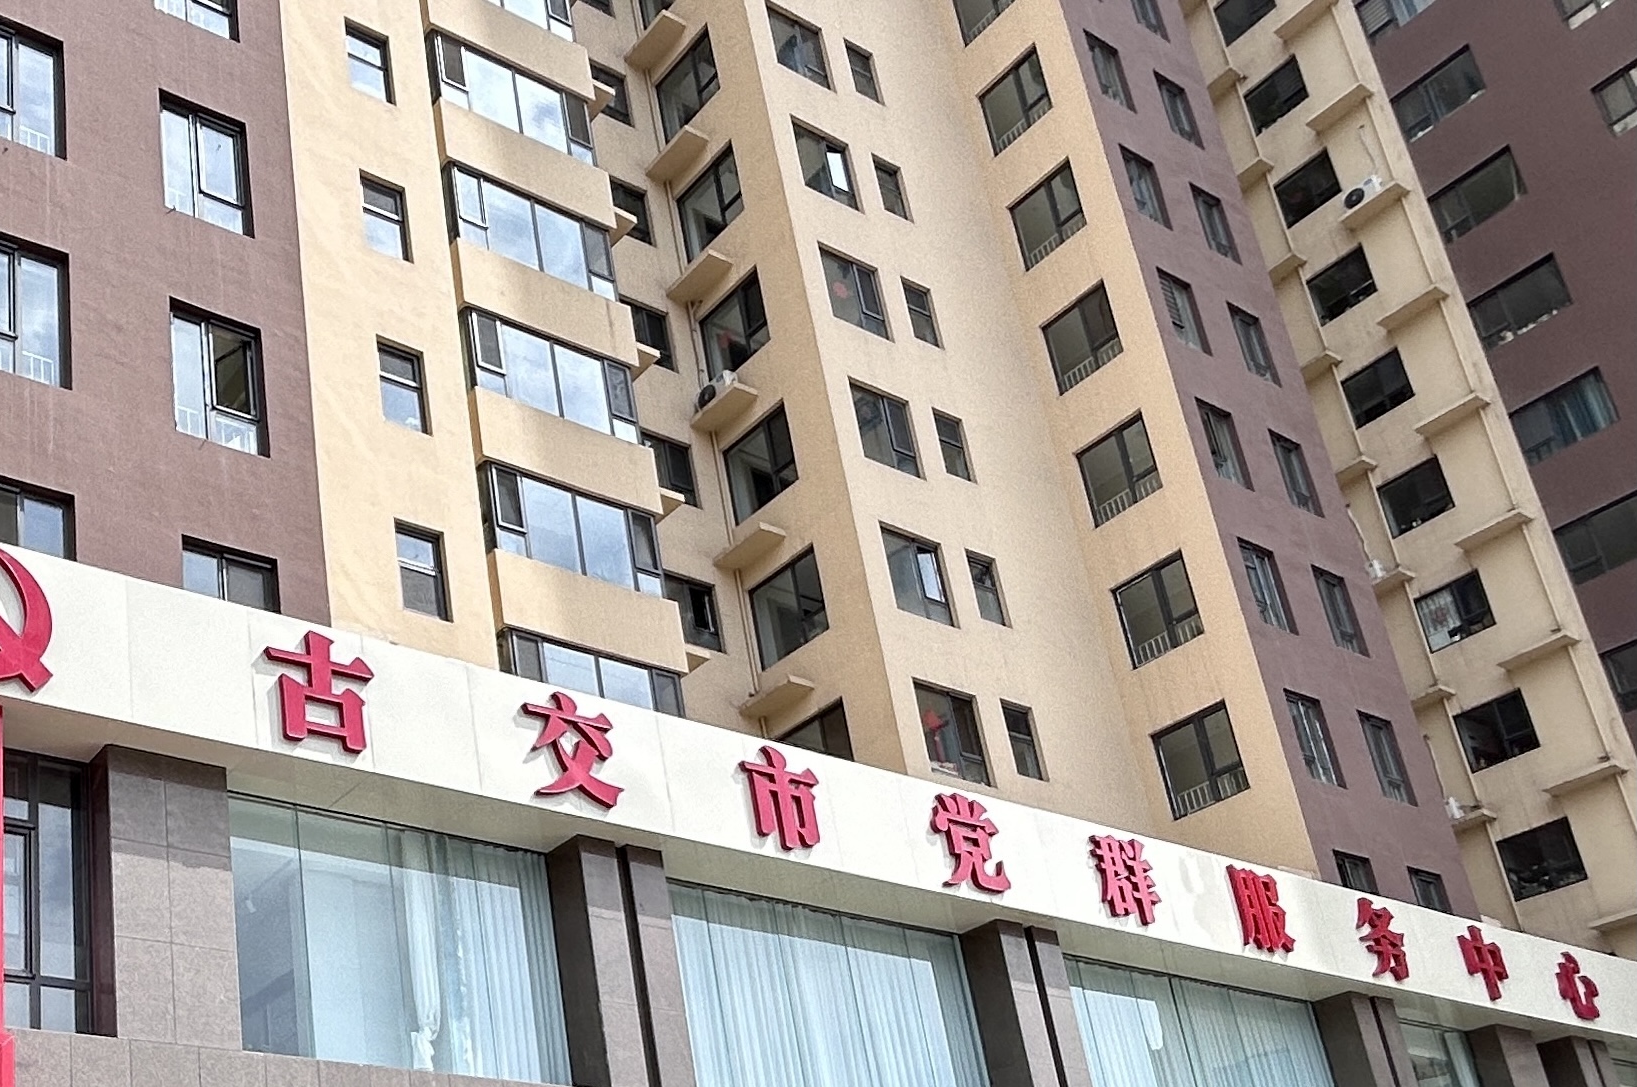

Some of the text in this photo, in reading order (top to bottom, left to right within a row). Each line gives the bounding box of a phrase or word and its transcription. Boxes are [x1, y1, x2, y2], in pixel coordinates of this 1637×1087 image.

[264, 630, 1601, 1021] 古交市党群服务中心
